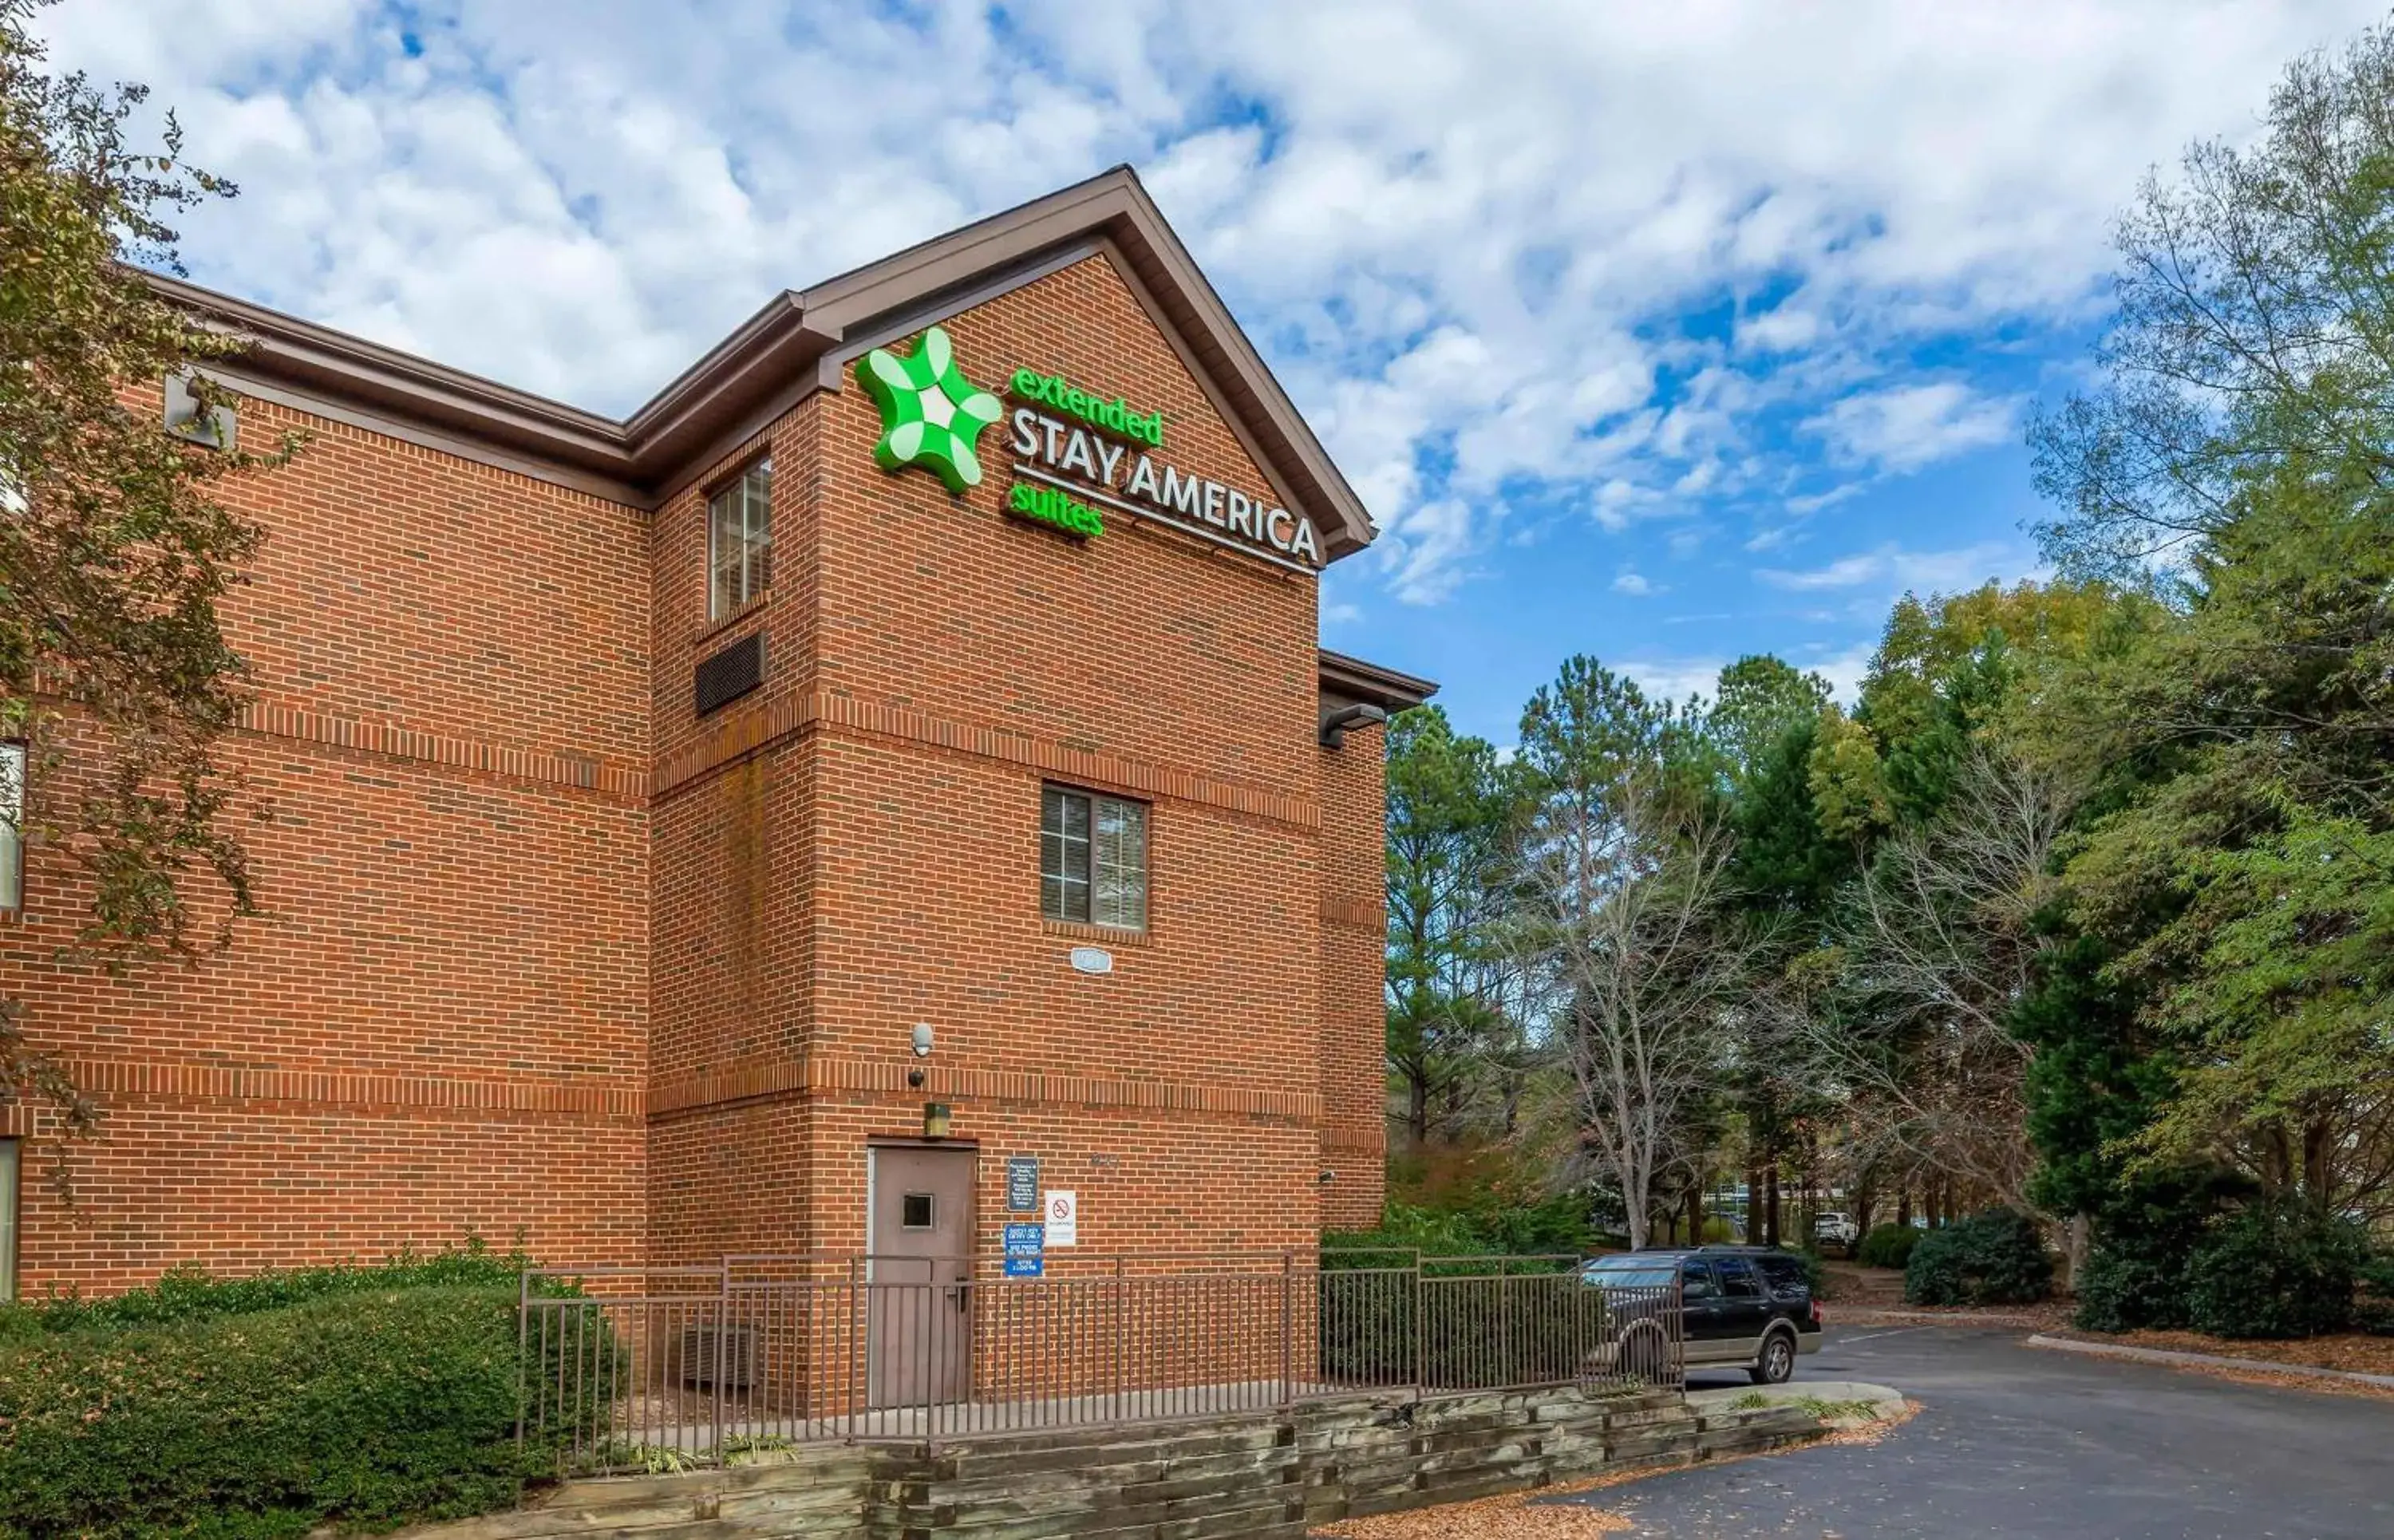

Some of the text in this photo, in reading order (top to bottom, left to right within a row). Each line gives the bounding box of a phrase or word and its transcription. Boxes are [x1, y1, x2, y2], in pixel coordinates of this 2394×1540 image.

[1011, 368, 1163, 446] extended
[1011, 482, 1104, 536] suites
[1013, 408, 1318, 562] STAY AMERICA
